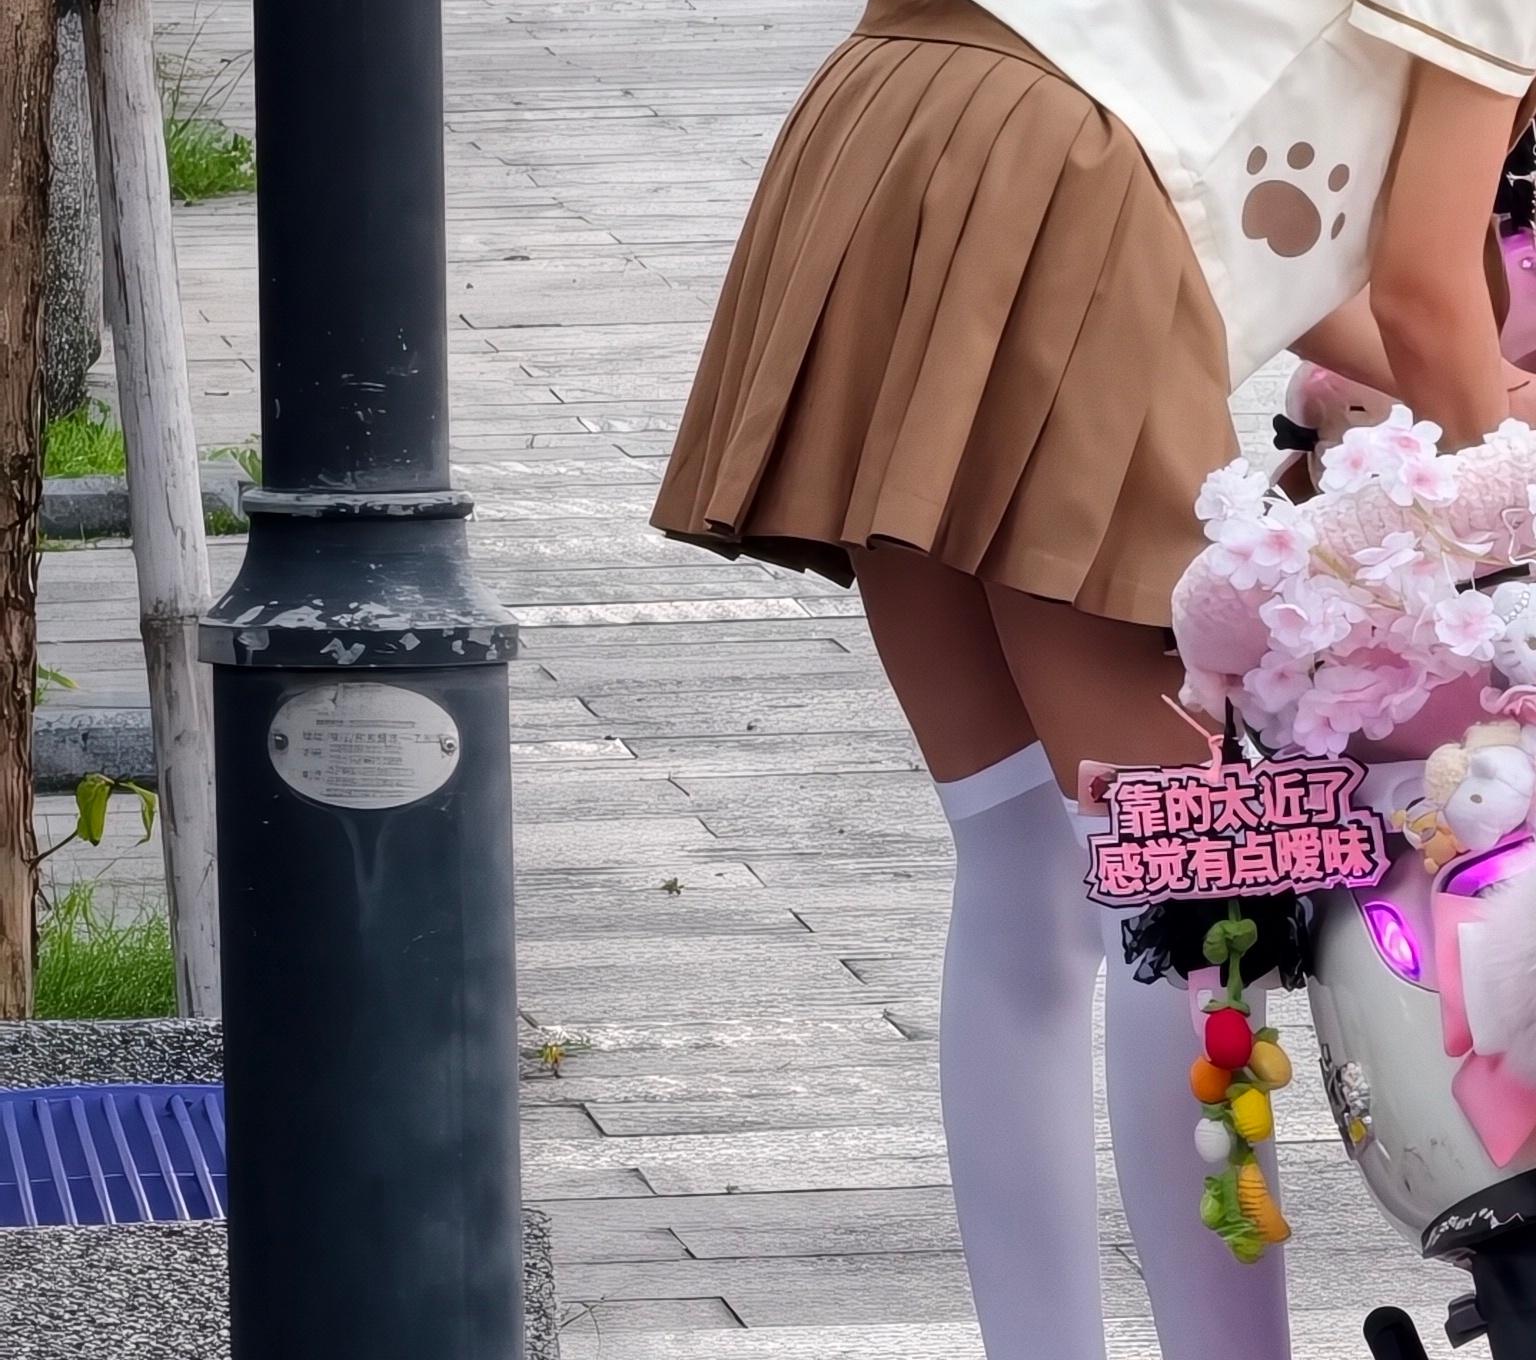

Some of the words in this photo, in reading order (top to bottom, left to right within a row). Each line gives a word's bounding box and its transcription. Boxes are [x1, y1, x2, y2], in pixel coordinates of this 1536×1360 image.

[1115, 770, 1348, 835] 靠的太近了
[1098, 825, 1372, 894] 感觉有点暧昧
